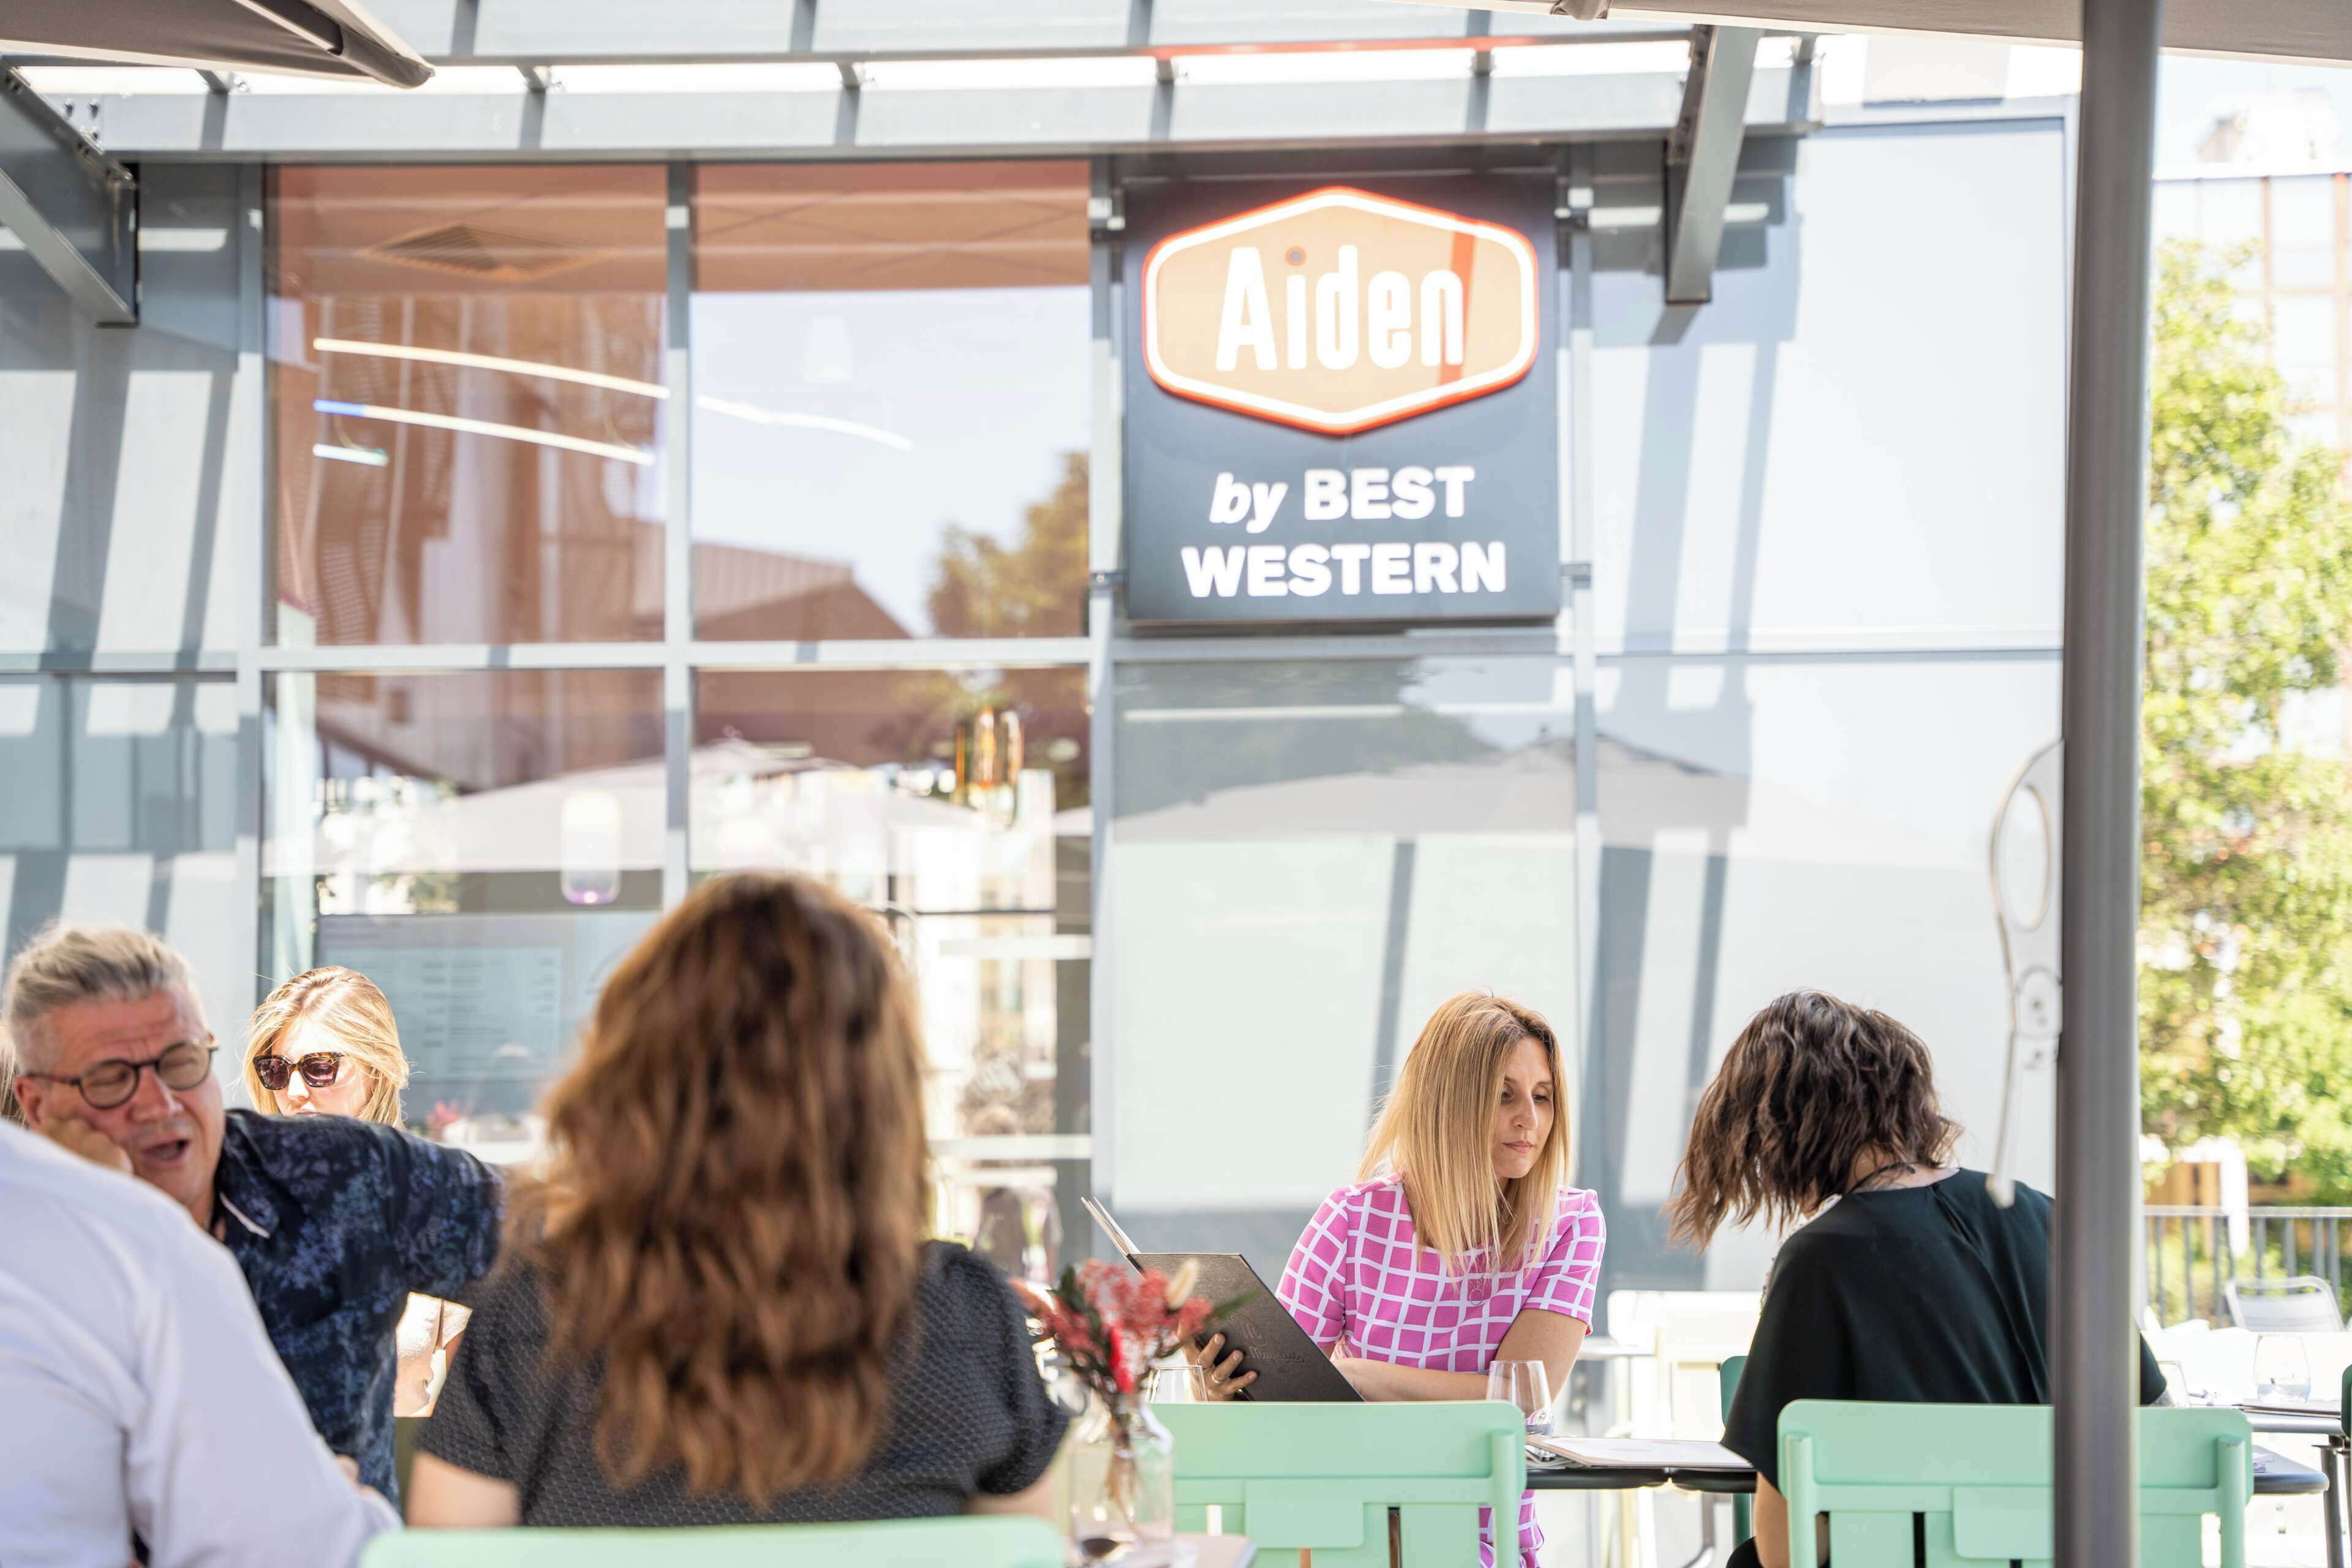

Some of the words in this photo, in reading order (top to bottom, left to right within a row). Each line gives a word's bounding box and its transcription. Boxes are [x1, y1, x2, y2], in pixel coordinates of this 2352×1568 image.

[1216, 246, 1463, 370] Aiden
[1210, 473, 1287, 533] by
[1305, 466, 1475, 521] BEST
[1181, 541, 1506, 597] WESTERN
